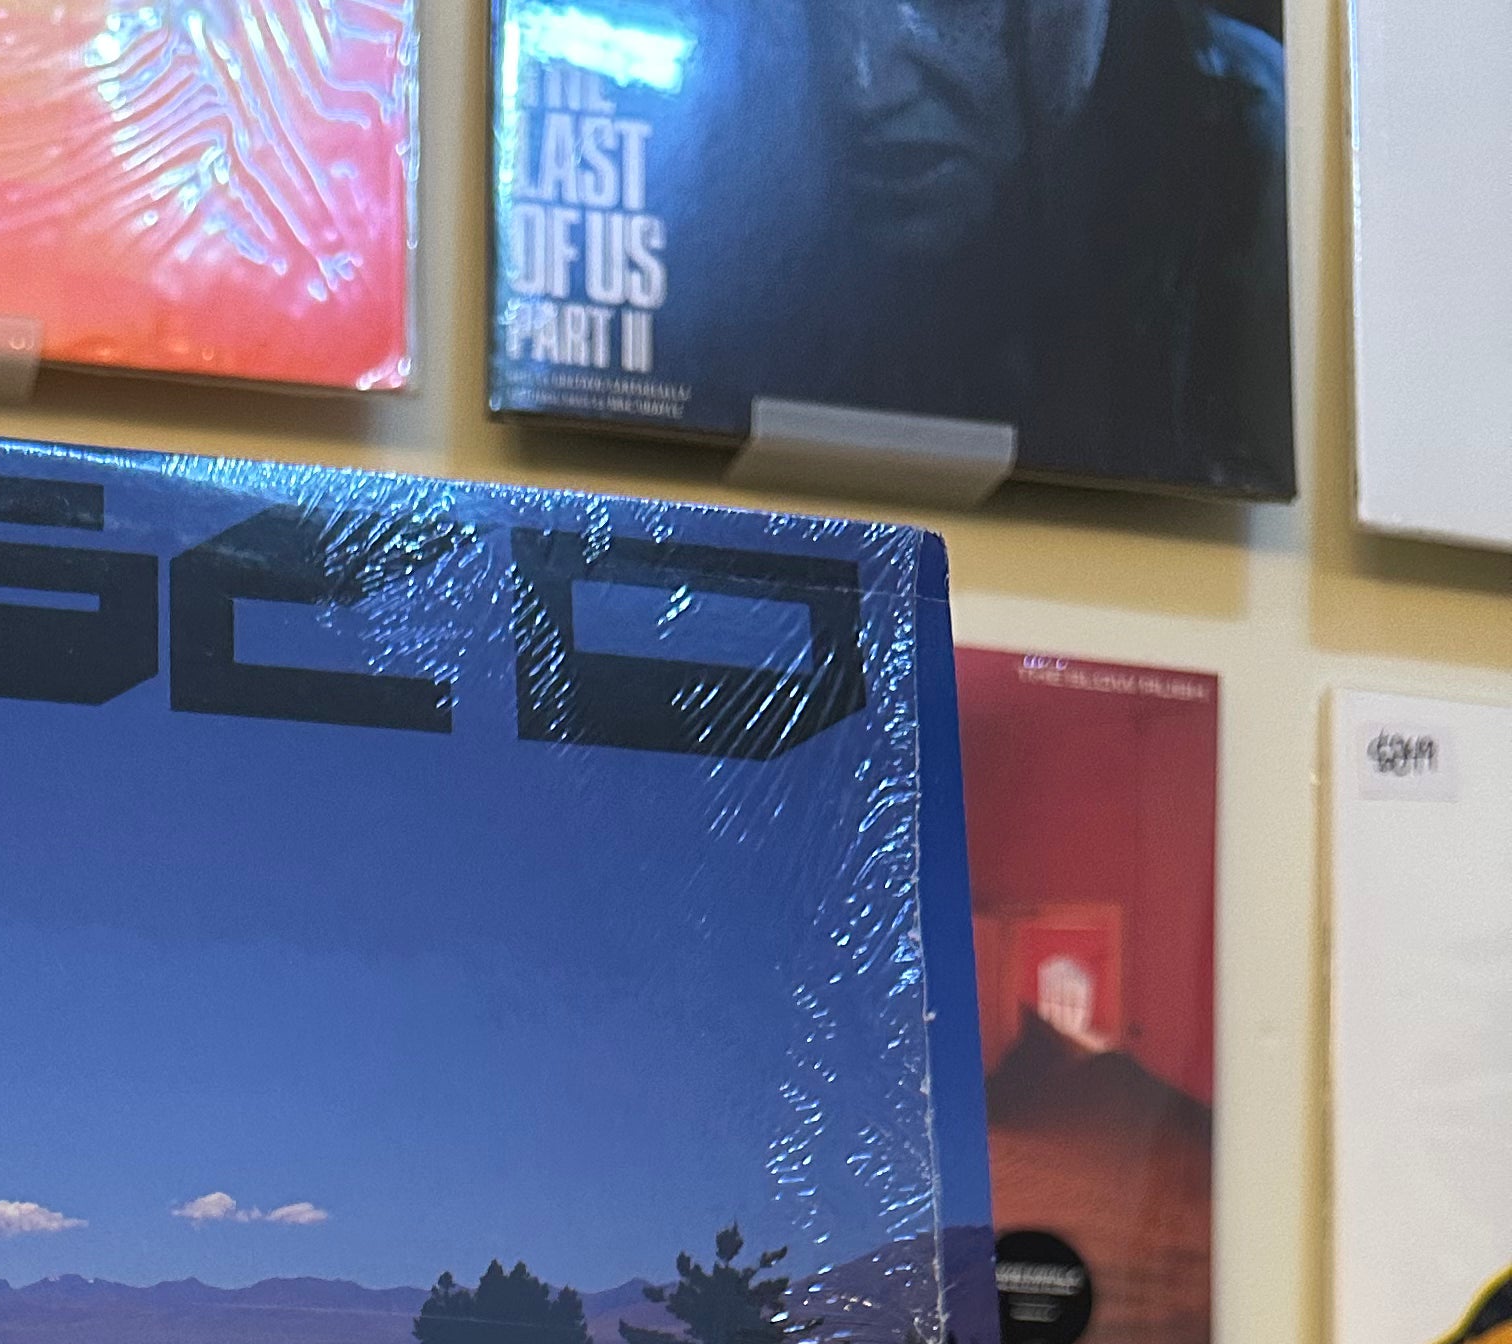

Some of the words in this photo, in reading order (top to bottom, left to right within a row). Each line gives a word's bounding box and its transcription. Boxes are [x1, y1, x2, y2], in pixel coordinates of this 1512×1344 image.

[513, 111, 654, 211] LAST
[508, 203, 581, 298] OF
[585, 209, 668, 310] US
[504, 302, 616, 368] PART
[620, 309, 654, 373] II
